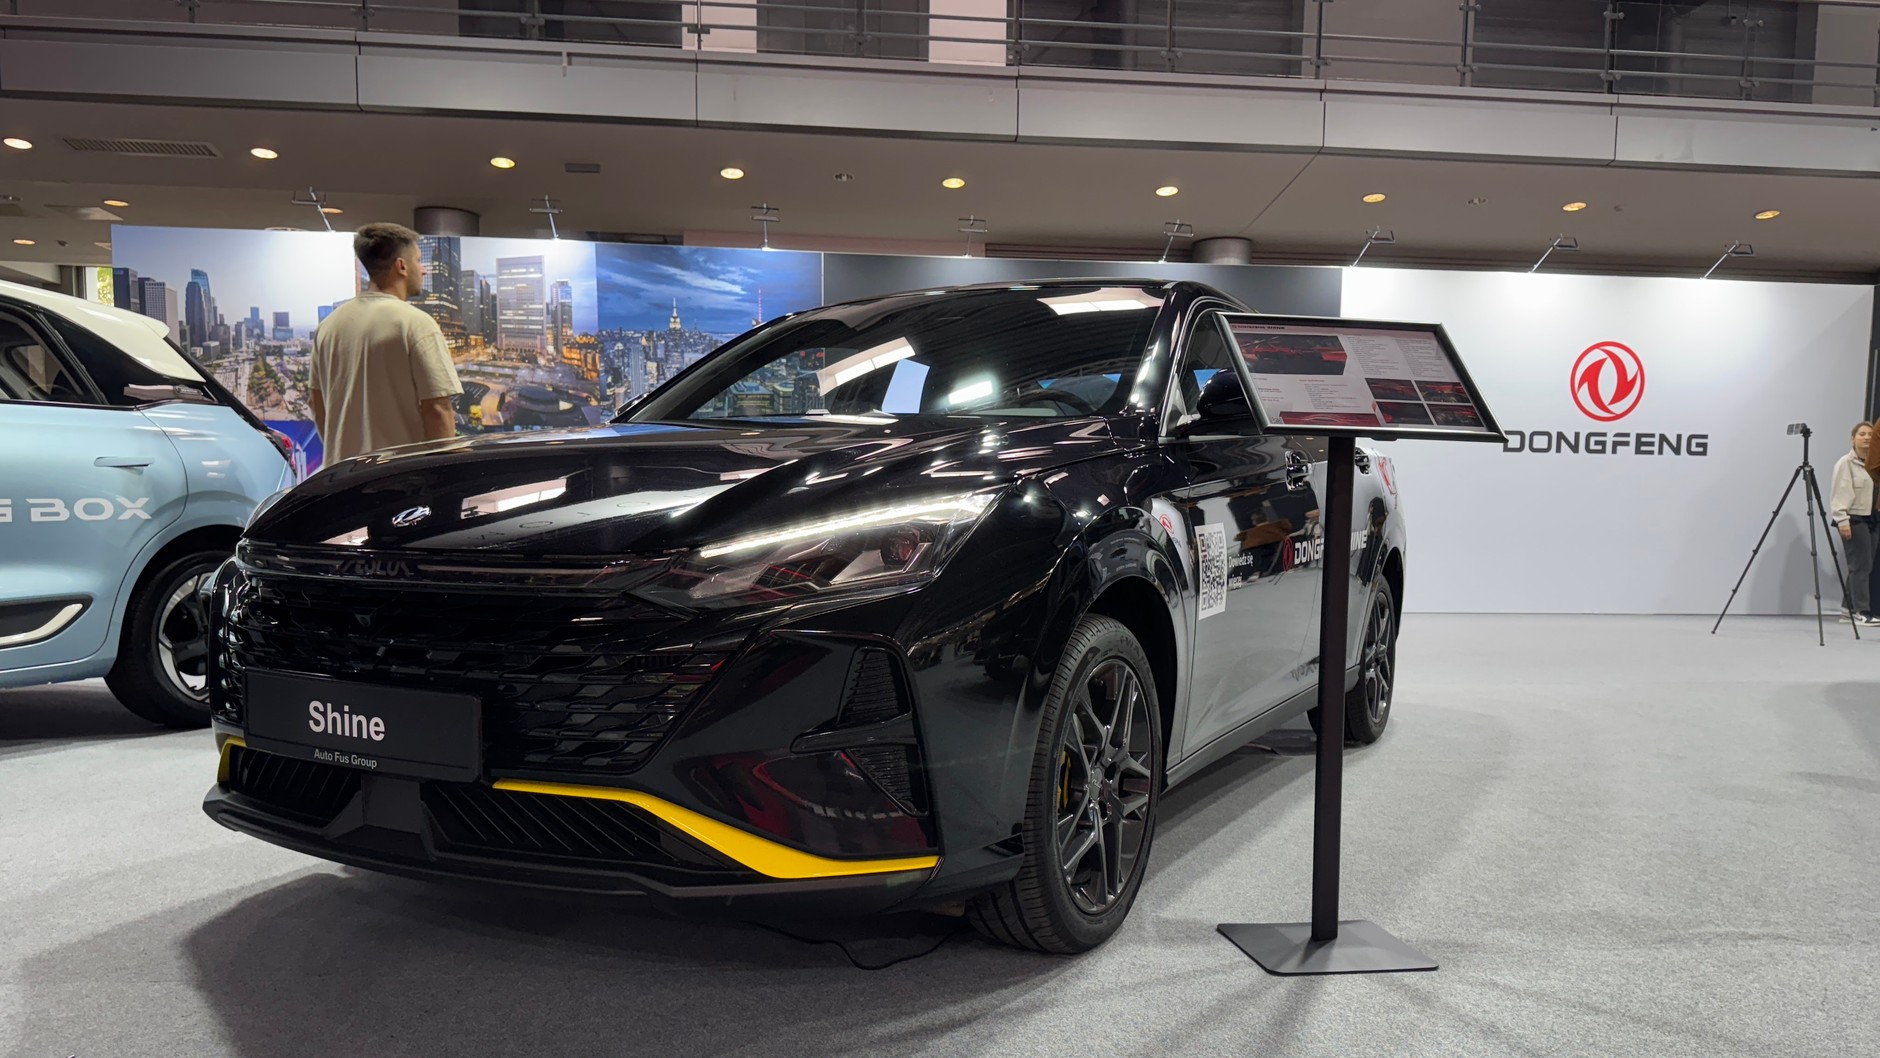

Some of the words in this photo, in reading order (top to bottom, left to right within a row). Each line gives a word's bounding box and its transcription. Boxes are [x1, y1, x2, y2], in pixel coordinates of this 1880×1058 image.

[1502, 430, 1709, 456] DONGFENG
[25, 497, 153, 522] BOX
[308, 700, 385, 742] Shine
[313, 748, 333, 761] Auto
[334, 751, 350, 764] Fus
[350, 754, 378, 769] Group
